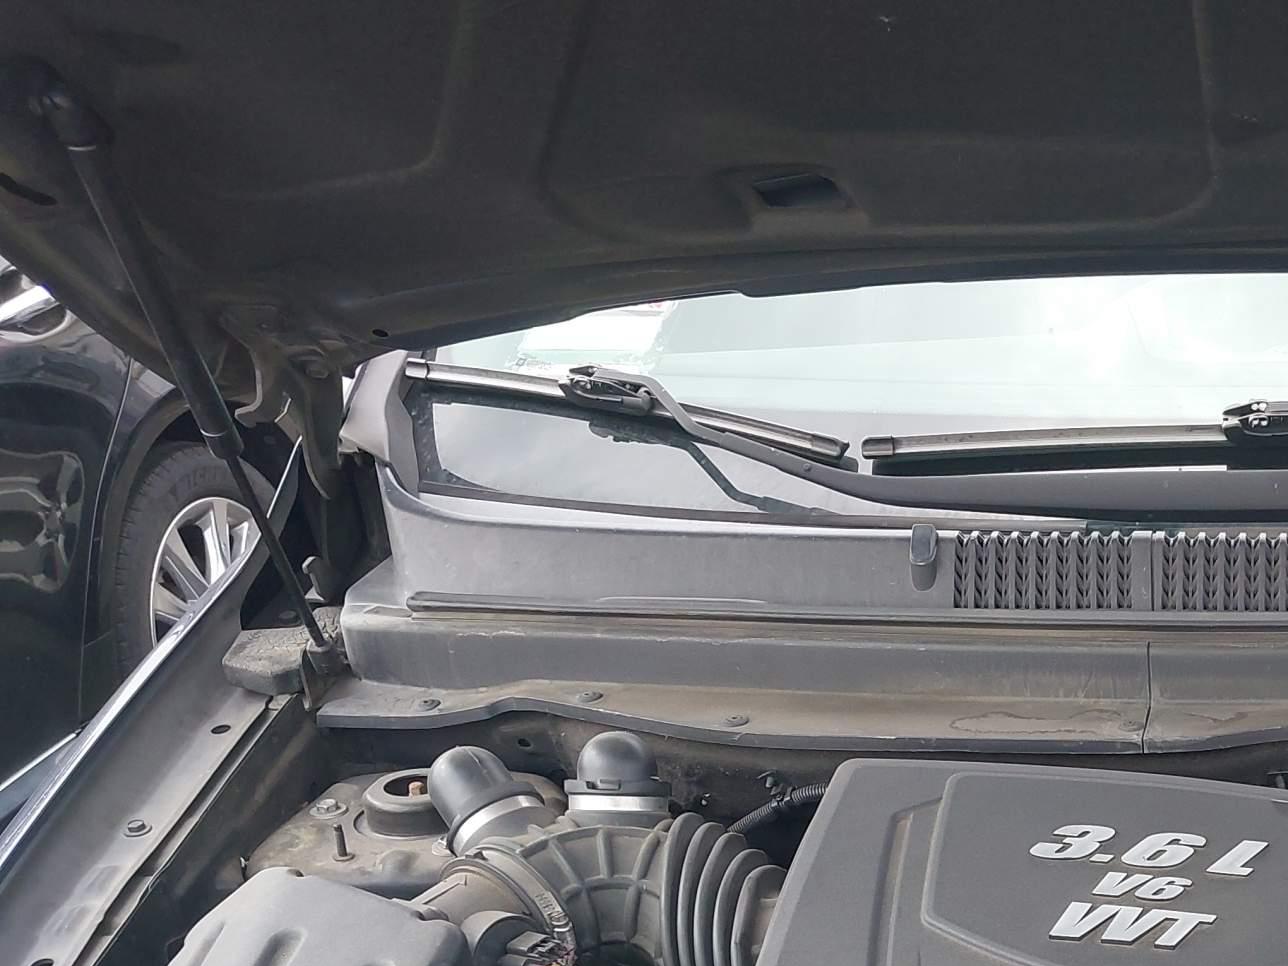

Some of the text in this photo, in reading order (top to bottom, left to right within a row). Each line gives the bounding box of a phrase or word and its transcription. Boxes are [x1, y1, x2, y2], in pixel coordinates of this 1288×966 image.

[1029, 824, 1269, 876] 3.6 L
[1091, 871, 1193, 900] V6
[1048, 901, 1218, 948] VVT
